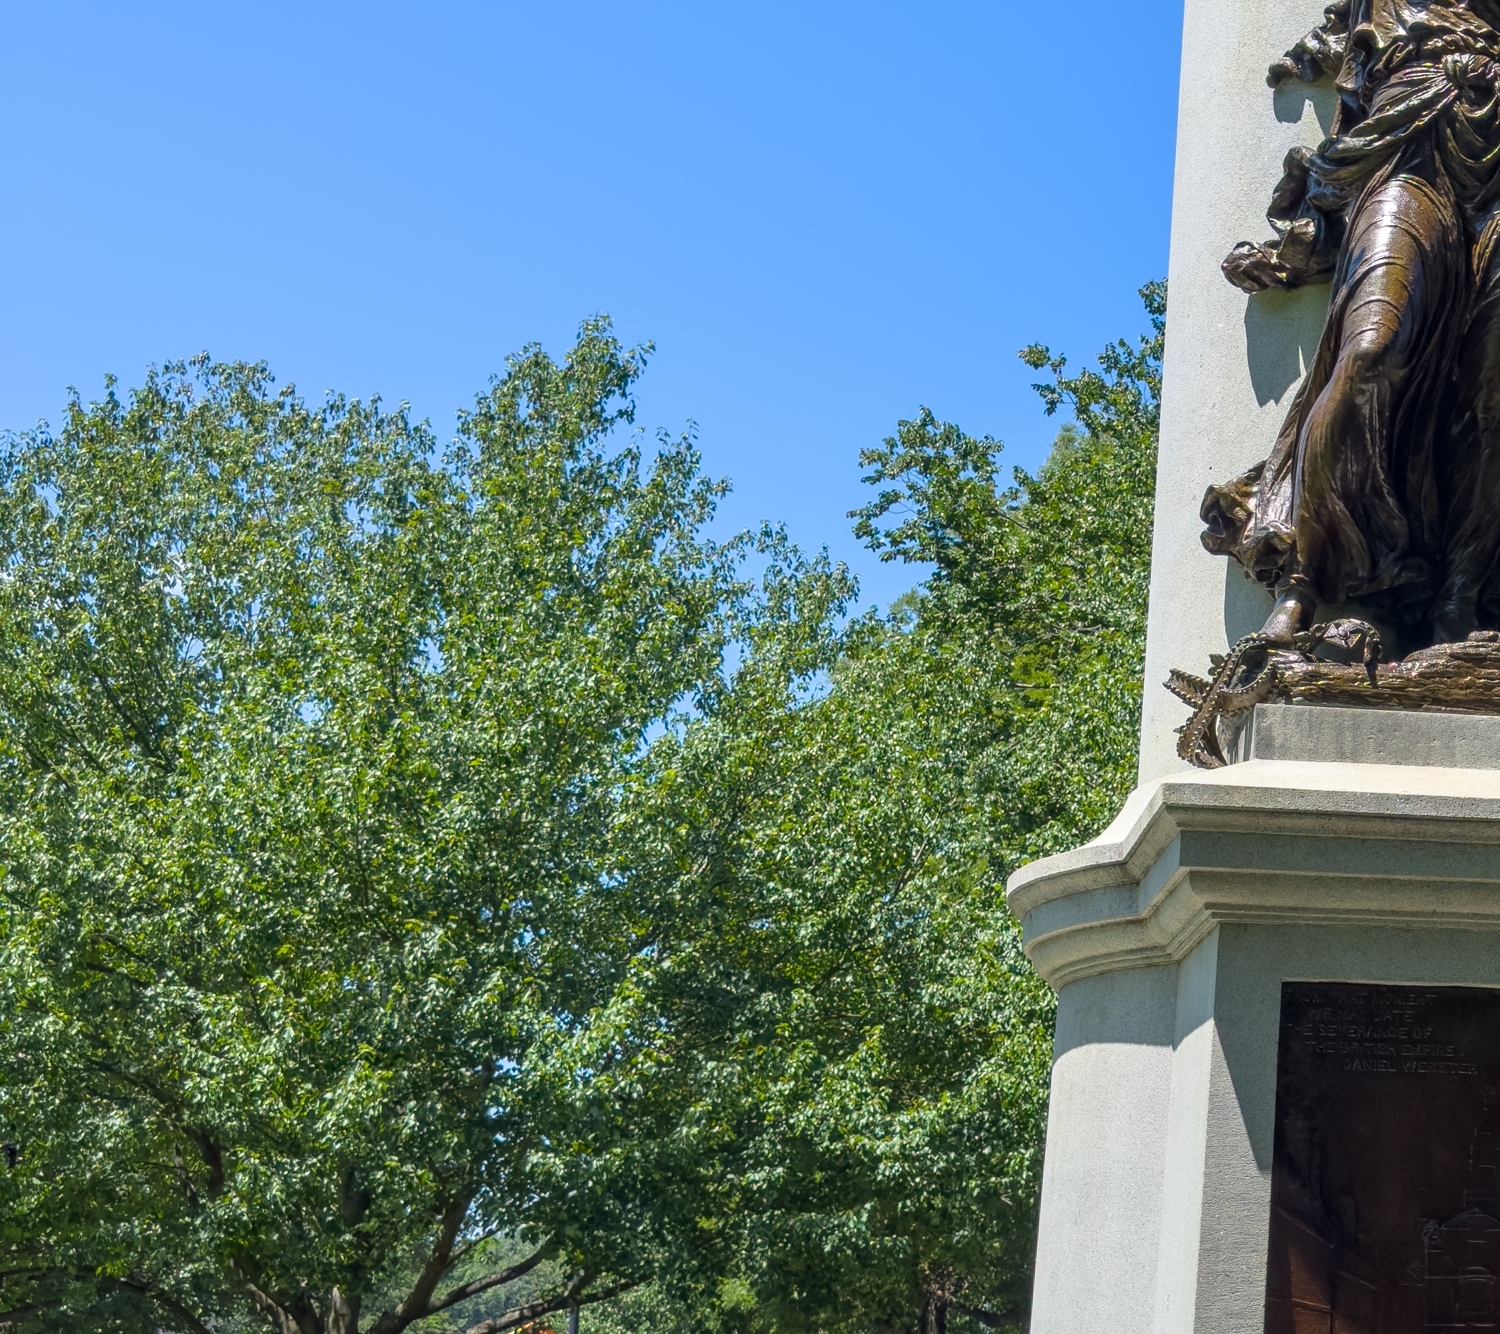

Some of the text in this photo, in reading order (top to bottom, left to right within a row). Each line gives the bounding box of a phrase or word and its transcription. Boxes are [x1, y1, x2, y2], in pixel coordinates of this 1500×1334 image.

[1319, 1024, 1408, 1038] SEVERANCE
[1412, 1027, 1433, 1040] OF
[1305, 1041, 1335, 1053] THE
[1339, 1041, 1397, 1055] BRITISH
[1343, 1059, 1477, 1075] DANIEL WEBSTER
